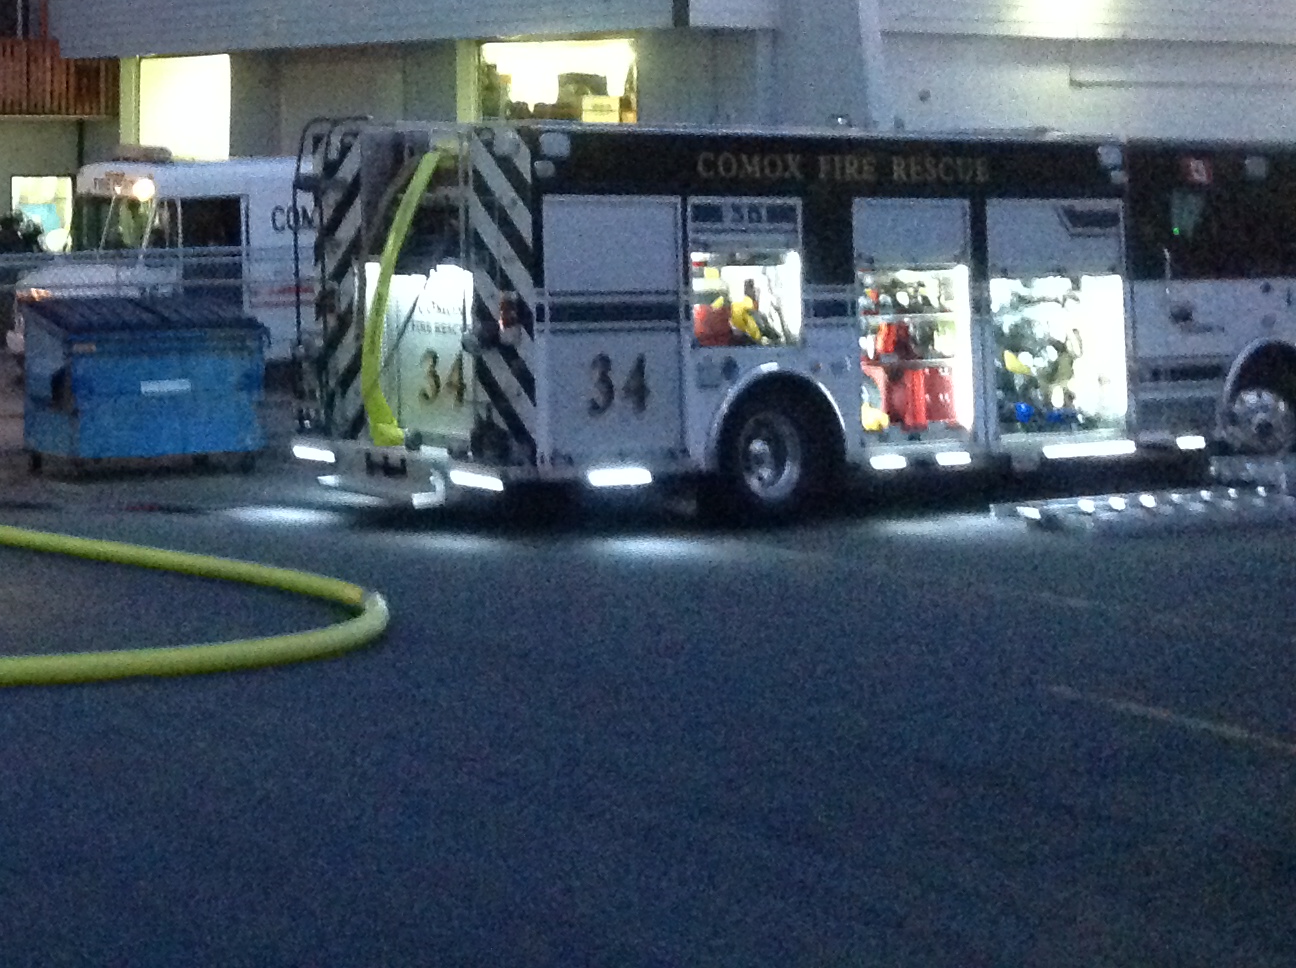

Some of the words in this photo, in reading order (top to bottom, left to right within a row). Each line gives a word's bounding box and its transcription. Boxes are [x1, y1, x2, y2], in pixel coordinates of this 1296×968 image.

[695, 151, 805, 180] COMOX
[816, 153, 879, 181] FIRE
[891, 155, 992, 184] RESCUE
[418, 348, 467, 408] 34
[588, 351, 651, 420] 34
